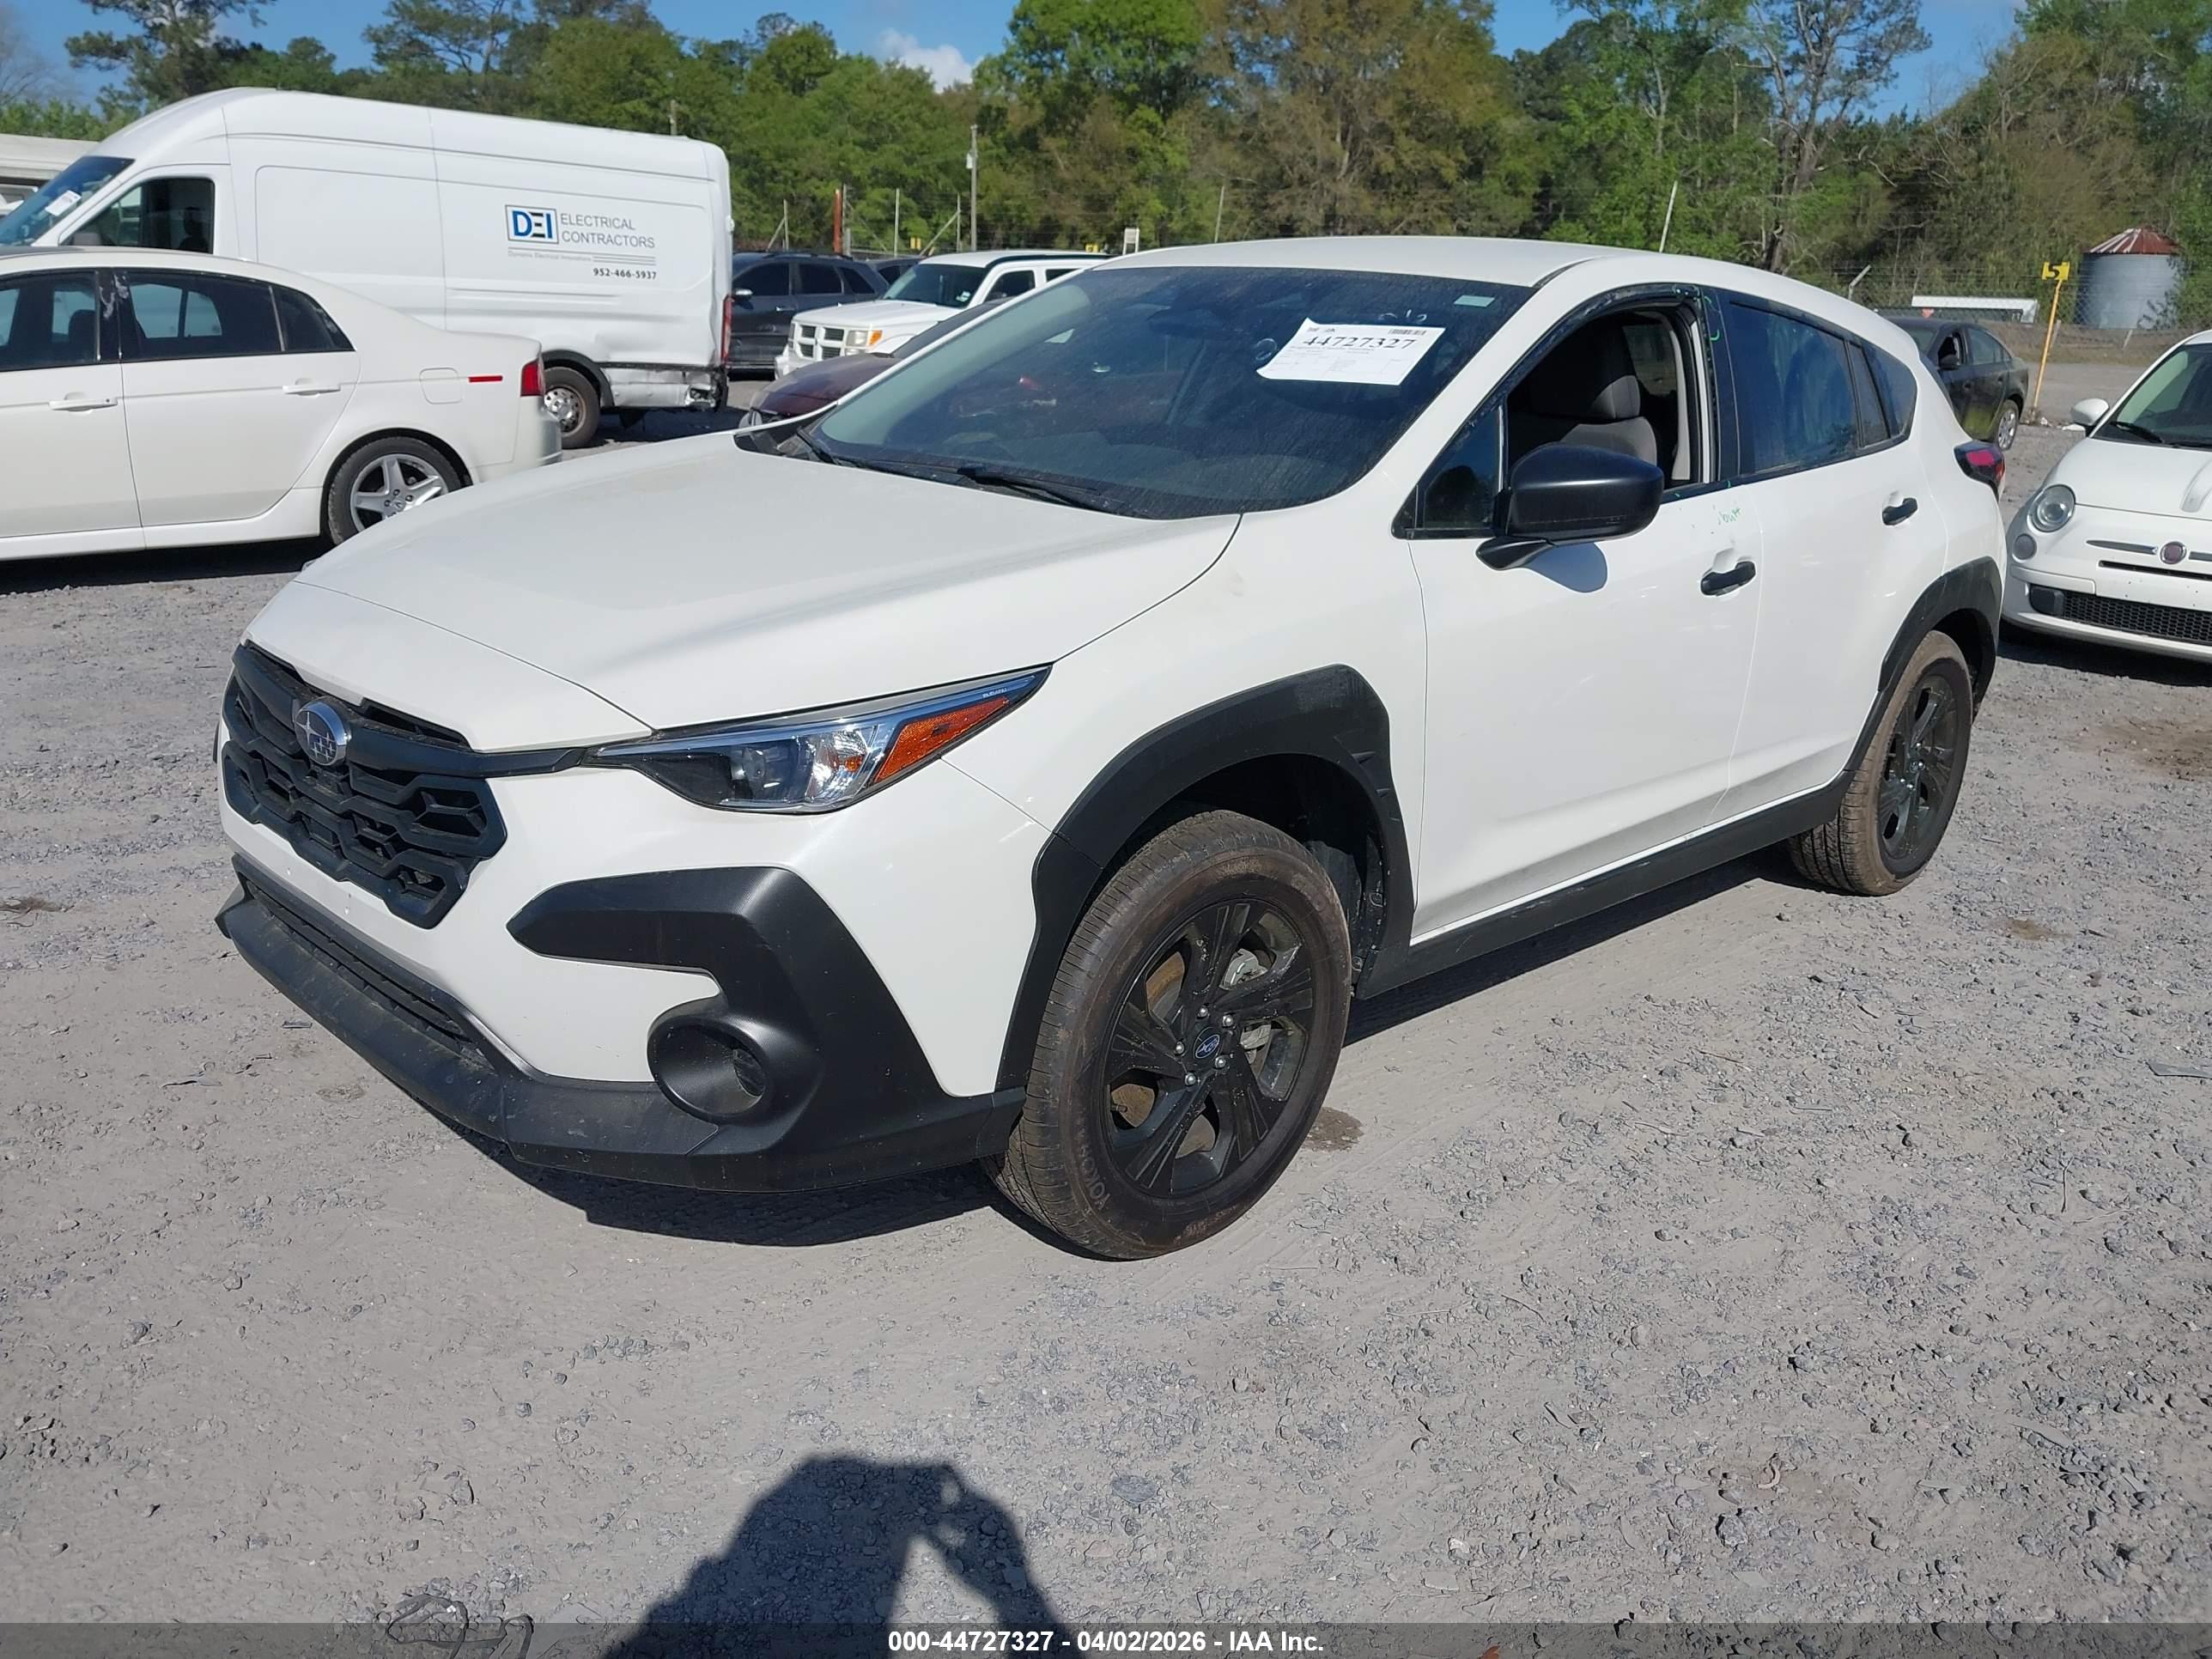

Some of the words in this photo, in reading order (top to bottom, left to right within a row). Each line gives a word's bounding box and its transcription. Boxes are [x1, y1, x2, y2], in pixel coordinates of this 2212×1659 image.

[512, 210, 553, 240] DEI
[561, 213, 635, 230] ELECTRICAL
[562, 230, 655, 248] CONTRACTORS
[592, 268, 657, 279] 952-466-5937
[1304, 336, 1416, 349] 44727327
